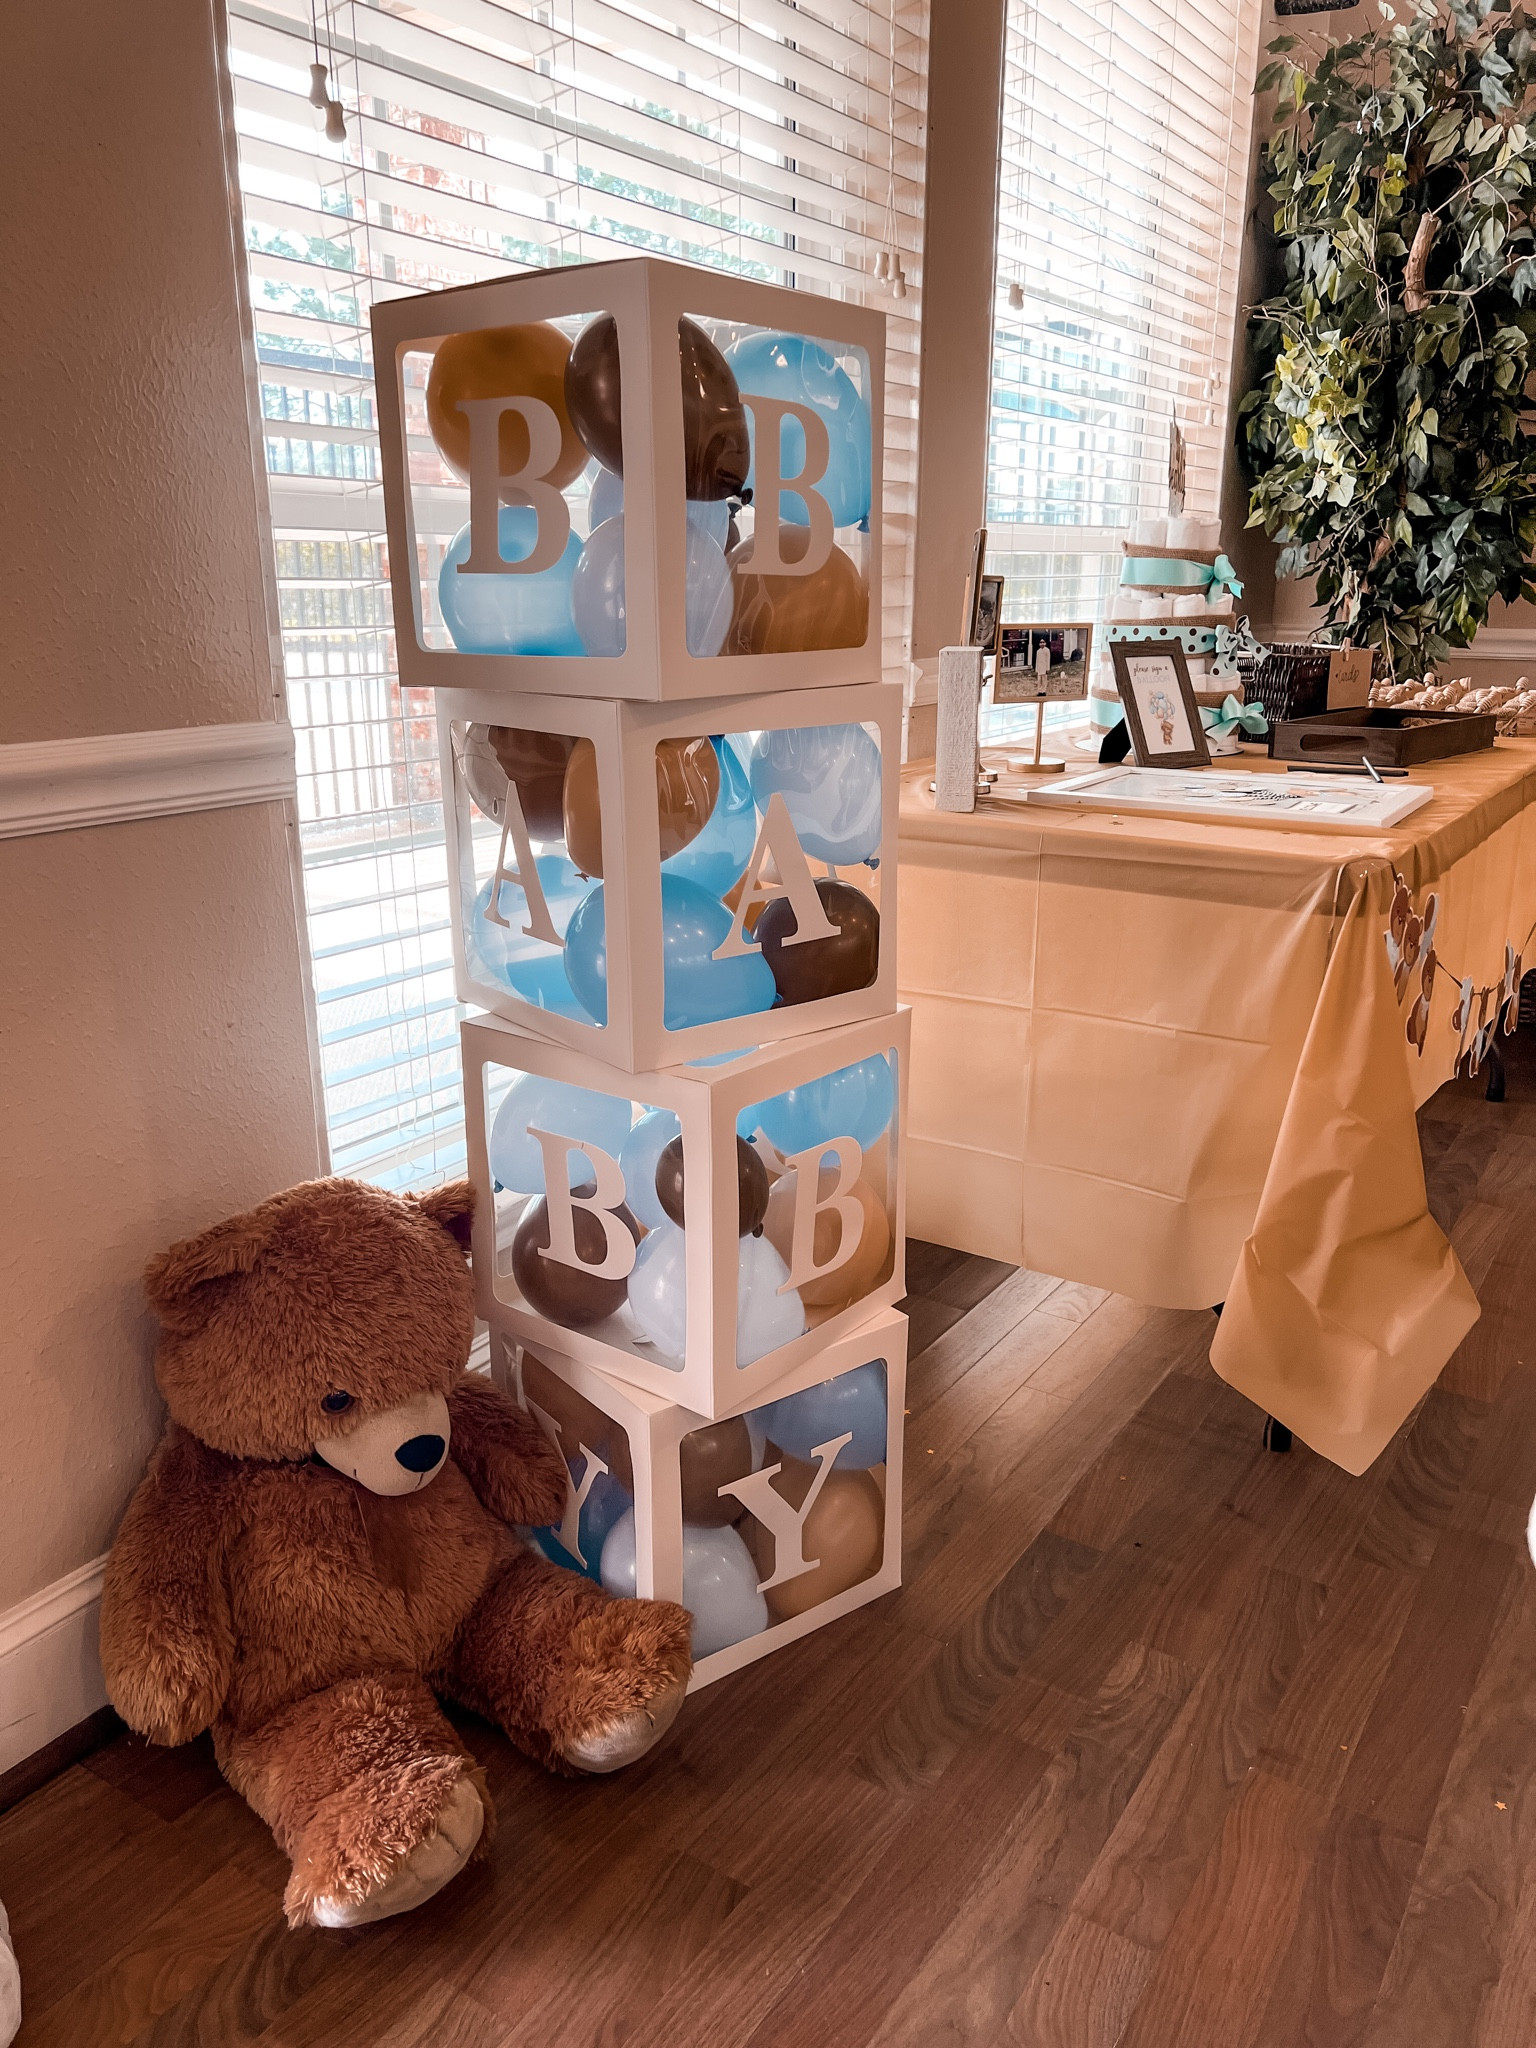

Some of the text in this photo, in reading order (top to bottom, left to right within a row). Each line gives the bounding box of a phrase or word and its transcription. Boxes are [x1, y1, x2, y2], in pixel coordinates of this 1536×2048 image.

[455, 395, 571, 575] B
[737, 392, 835, 577] B
[483, 780, 567, 948] A
[711, 793, 842, 961] A
[526, 1126, 637, 1280] B
[775, 1136, 866, 1296] B
[524, 1395, 609, 1570] Y
[717, 1431, 853, 1594] Y
